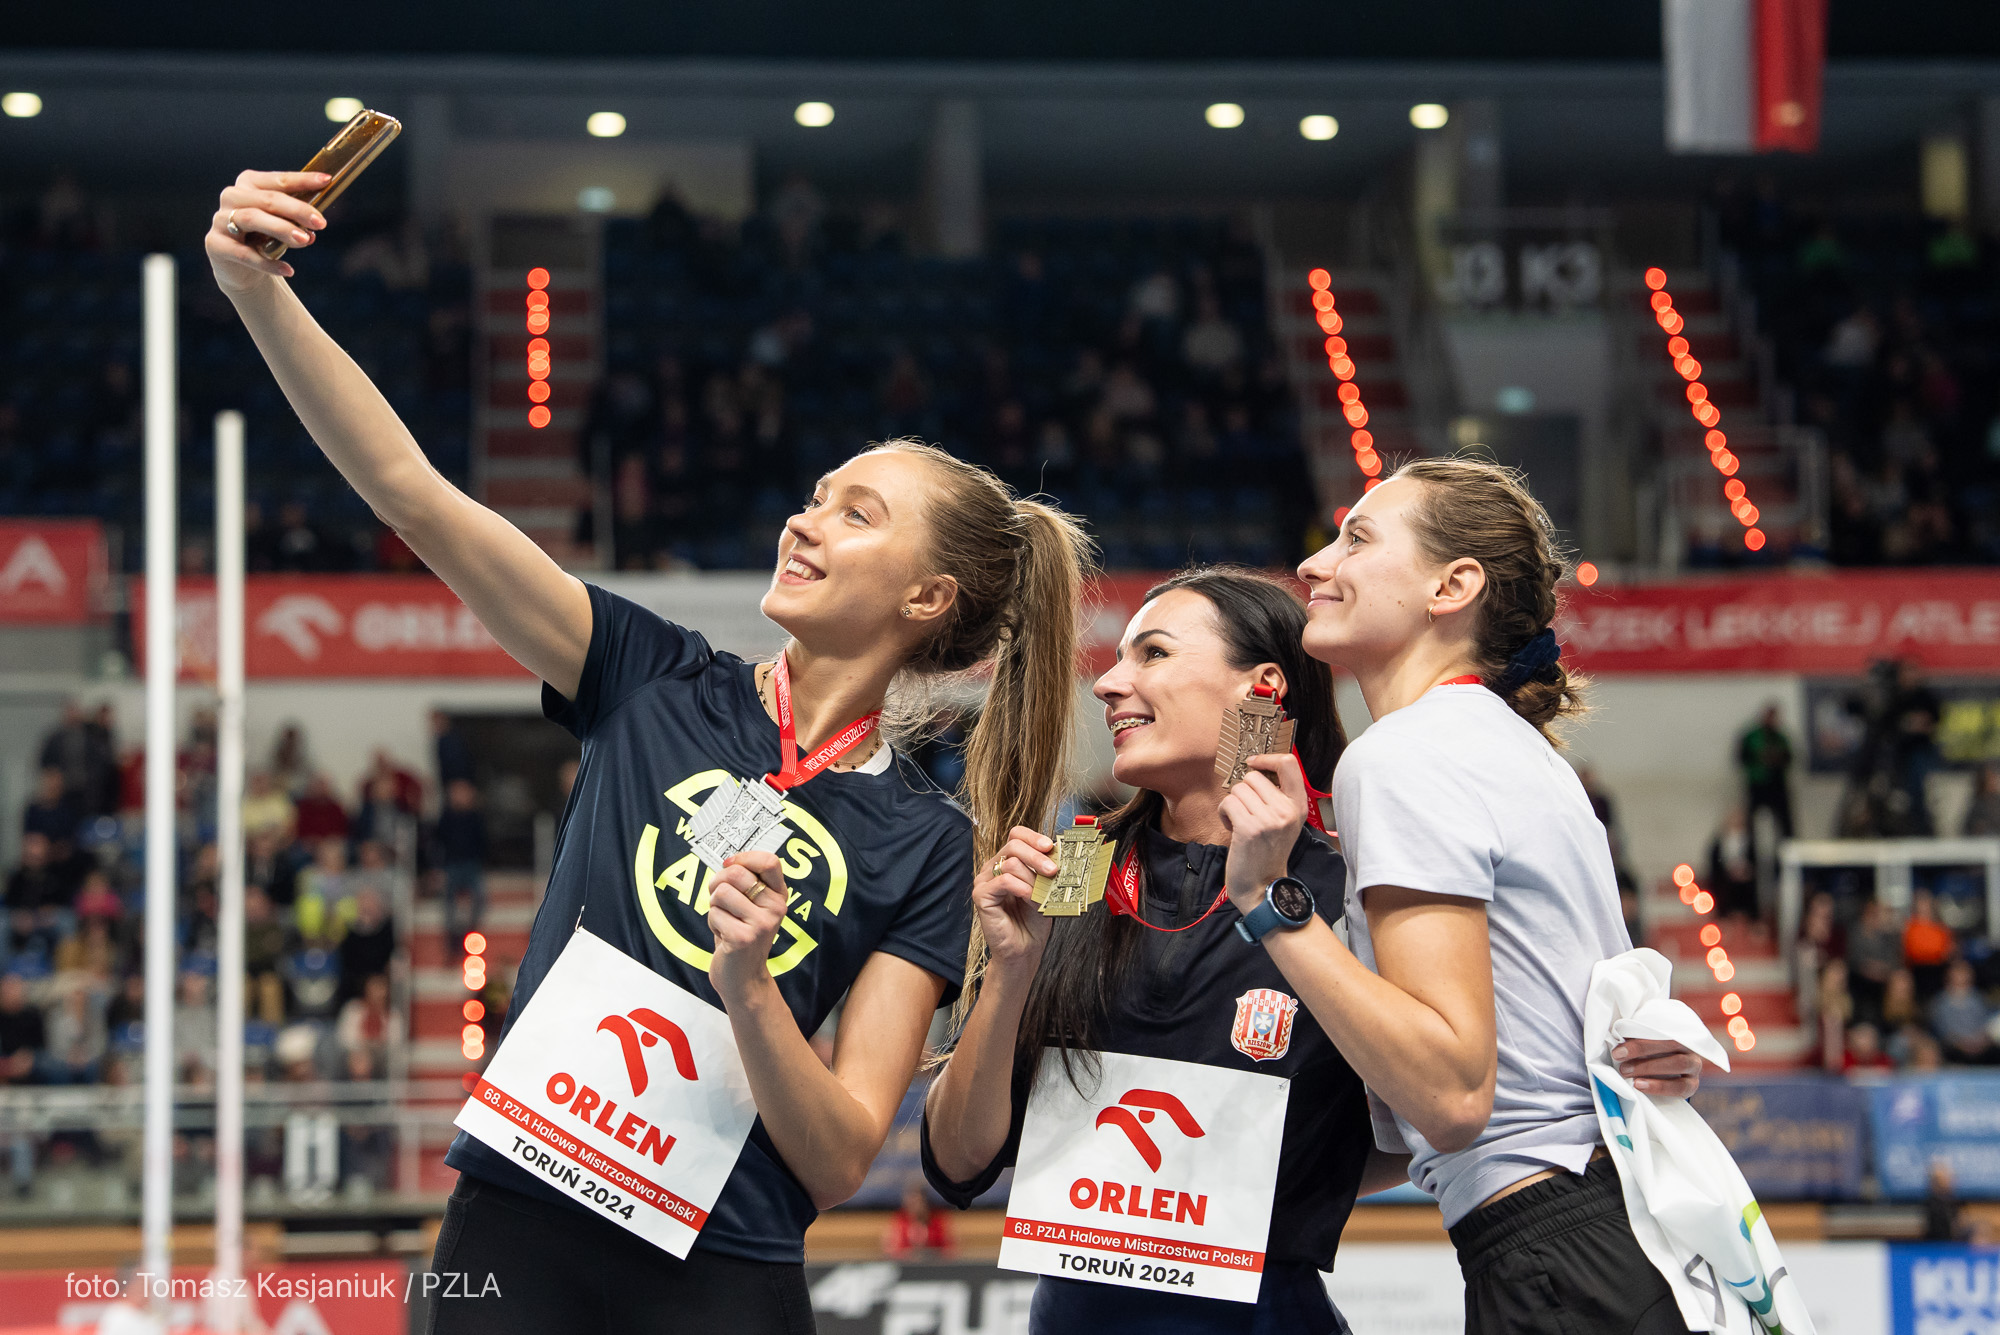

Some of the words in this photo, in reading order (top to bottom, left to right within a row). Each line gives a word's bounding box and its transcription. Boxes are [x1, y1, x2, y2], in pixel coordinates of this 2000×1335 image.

[354, 604, 496, 652] ORLE
[546, 1072, 677, 1166] ORLEN
[483, 1088, 501, 1107] 68.
[503, 1100, 530, 1126] PZLA
[530, 1117, 577, 1154] Halowe
[577, 1147, 657, 1201] Mistrzostwa
[657, 1193, 698, 1222] Polski
[511, 1136, 581, 1188] TORUŃ
[580, 1180, 636, 1221] 2024
[1069, 1177, 1208, 1226] ORLEN
[1014, 1222, 1033, 1236] 68.
[1036, 1225, 1066, 1240] PZLA
[1070, 1228, 1121, 1248] Halowe
[1124, 1233, 1209, 1261] Mistrzostwa
[1212, 1250, 1254, 1267] Polski
[1058, 1253, 1135, 1279] TORUŃ
[1139, 1264, 1195, 1288] 2024
